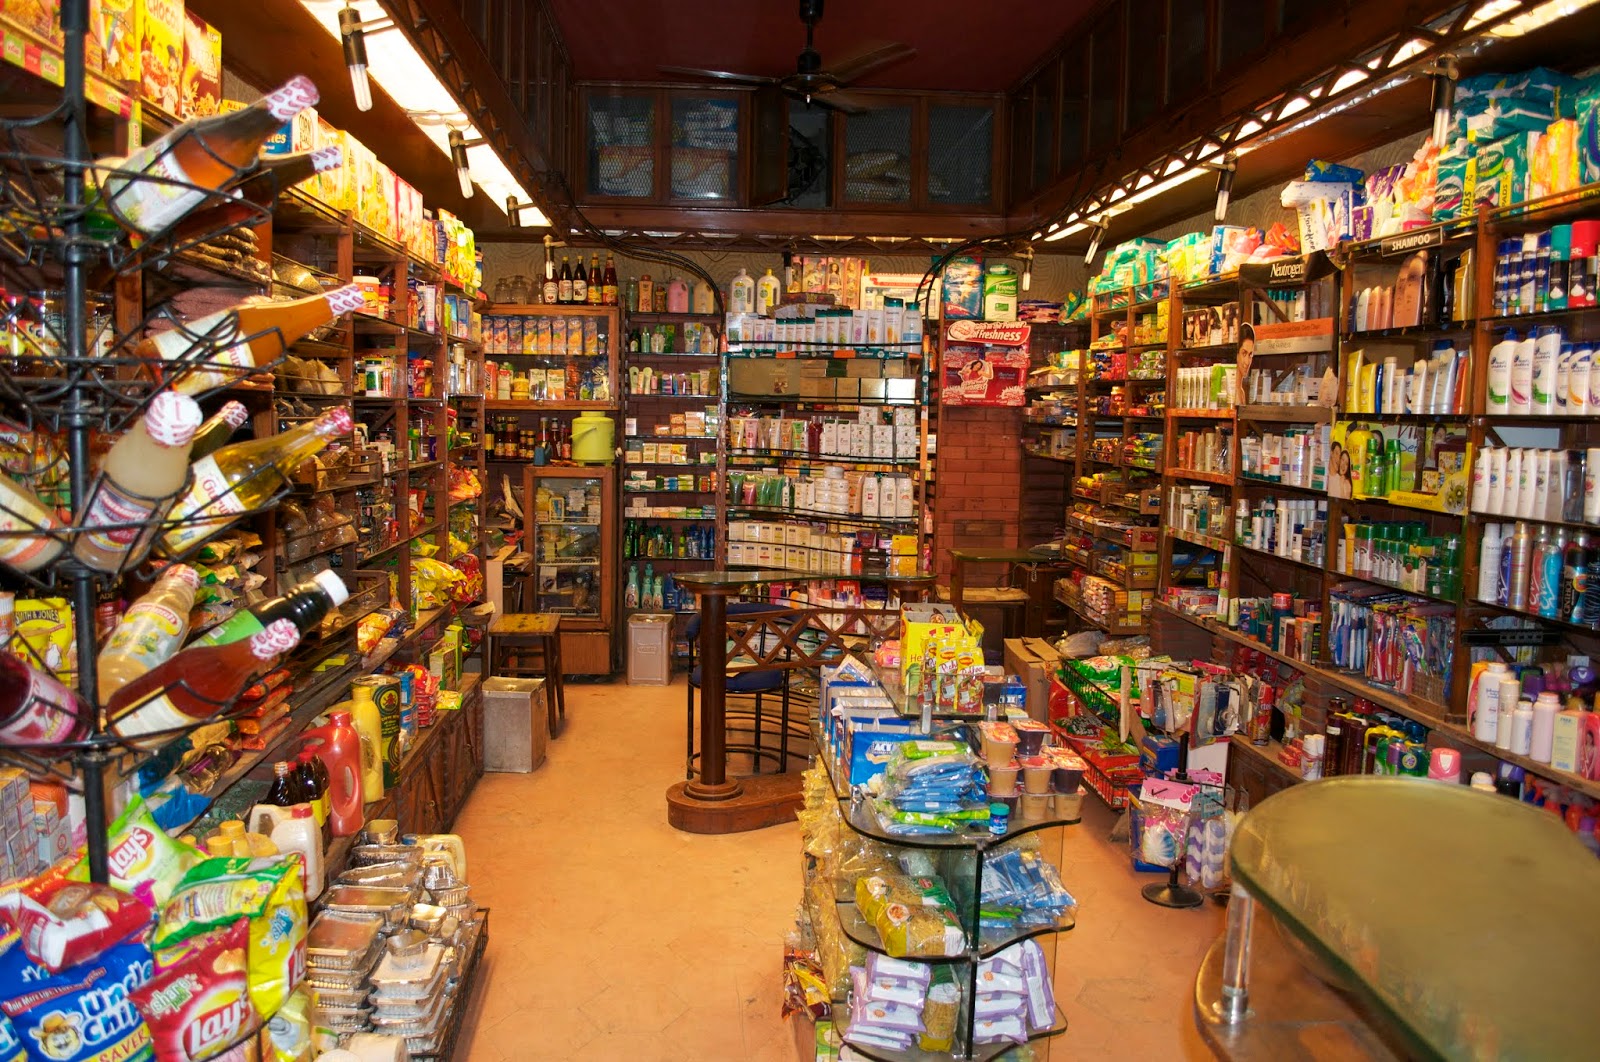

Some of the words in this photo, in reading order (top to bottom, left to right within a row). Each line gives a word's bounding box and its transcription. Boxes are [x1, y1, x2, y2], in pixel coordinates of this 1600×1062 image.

[1391, 233, 1431, 251] SHAMPOO
[1269, 262, 1304, 278] Neutrogen
[979, 327, 1022, 341] Freshness
[15, 611, 32, 625] SMITH
[38, 609, 60, 623] JONES
[99, 1027, 147, 1062] SAVER
